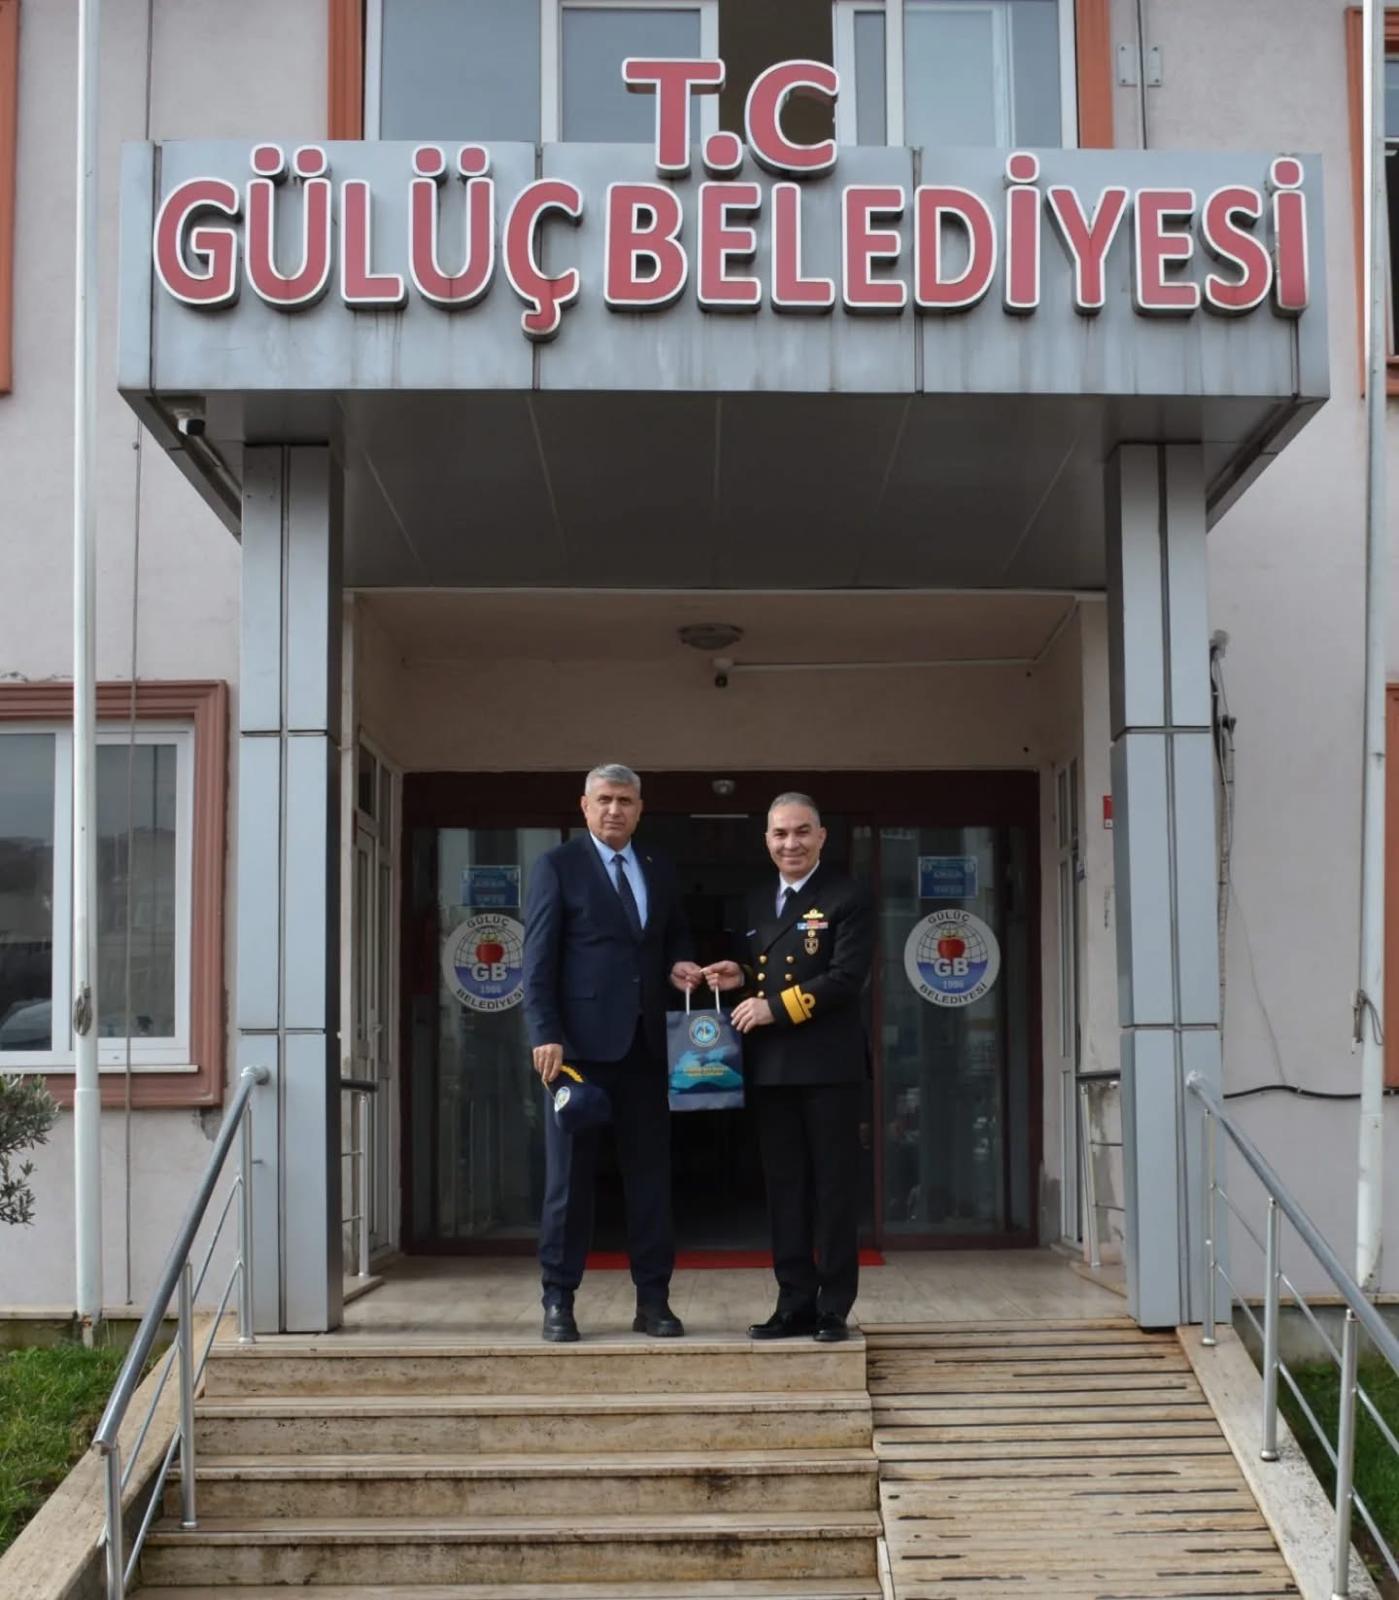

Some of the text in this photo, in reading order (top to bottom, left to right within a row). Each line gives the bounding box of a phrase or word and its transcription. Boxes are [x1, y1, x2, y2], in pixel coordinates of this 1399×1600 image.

[622, 57, 839, 172] T.C
[153, 144, 1309, 336] GÜLÜÇ BELEDİYESİ
[471, 963, 507, 982] GB
[934, 958, 969, 977] GB
